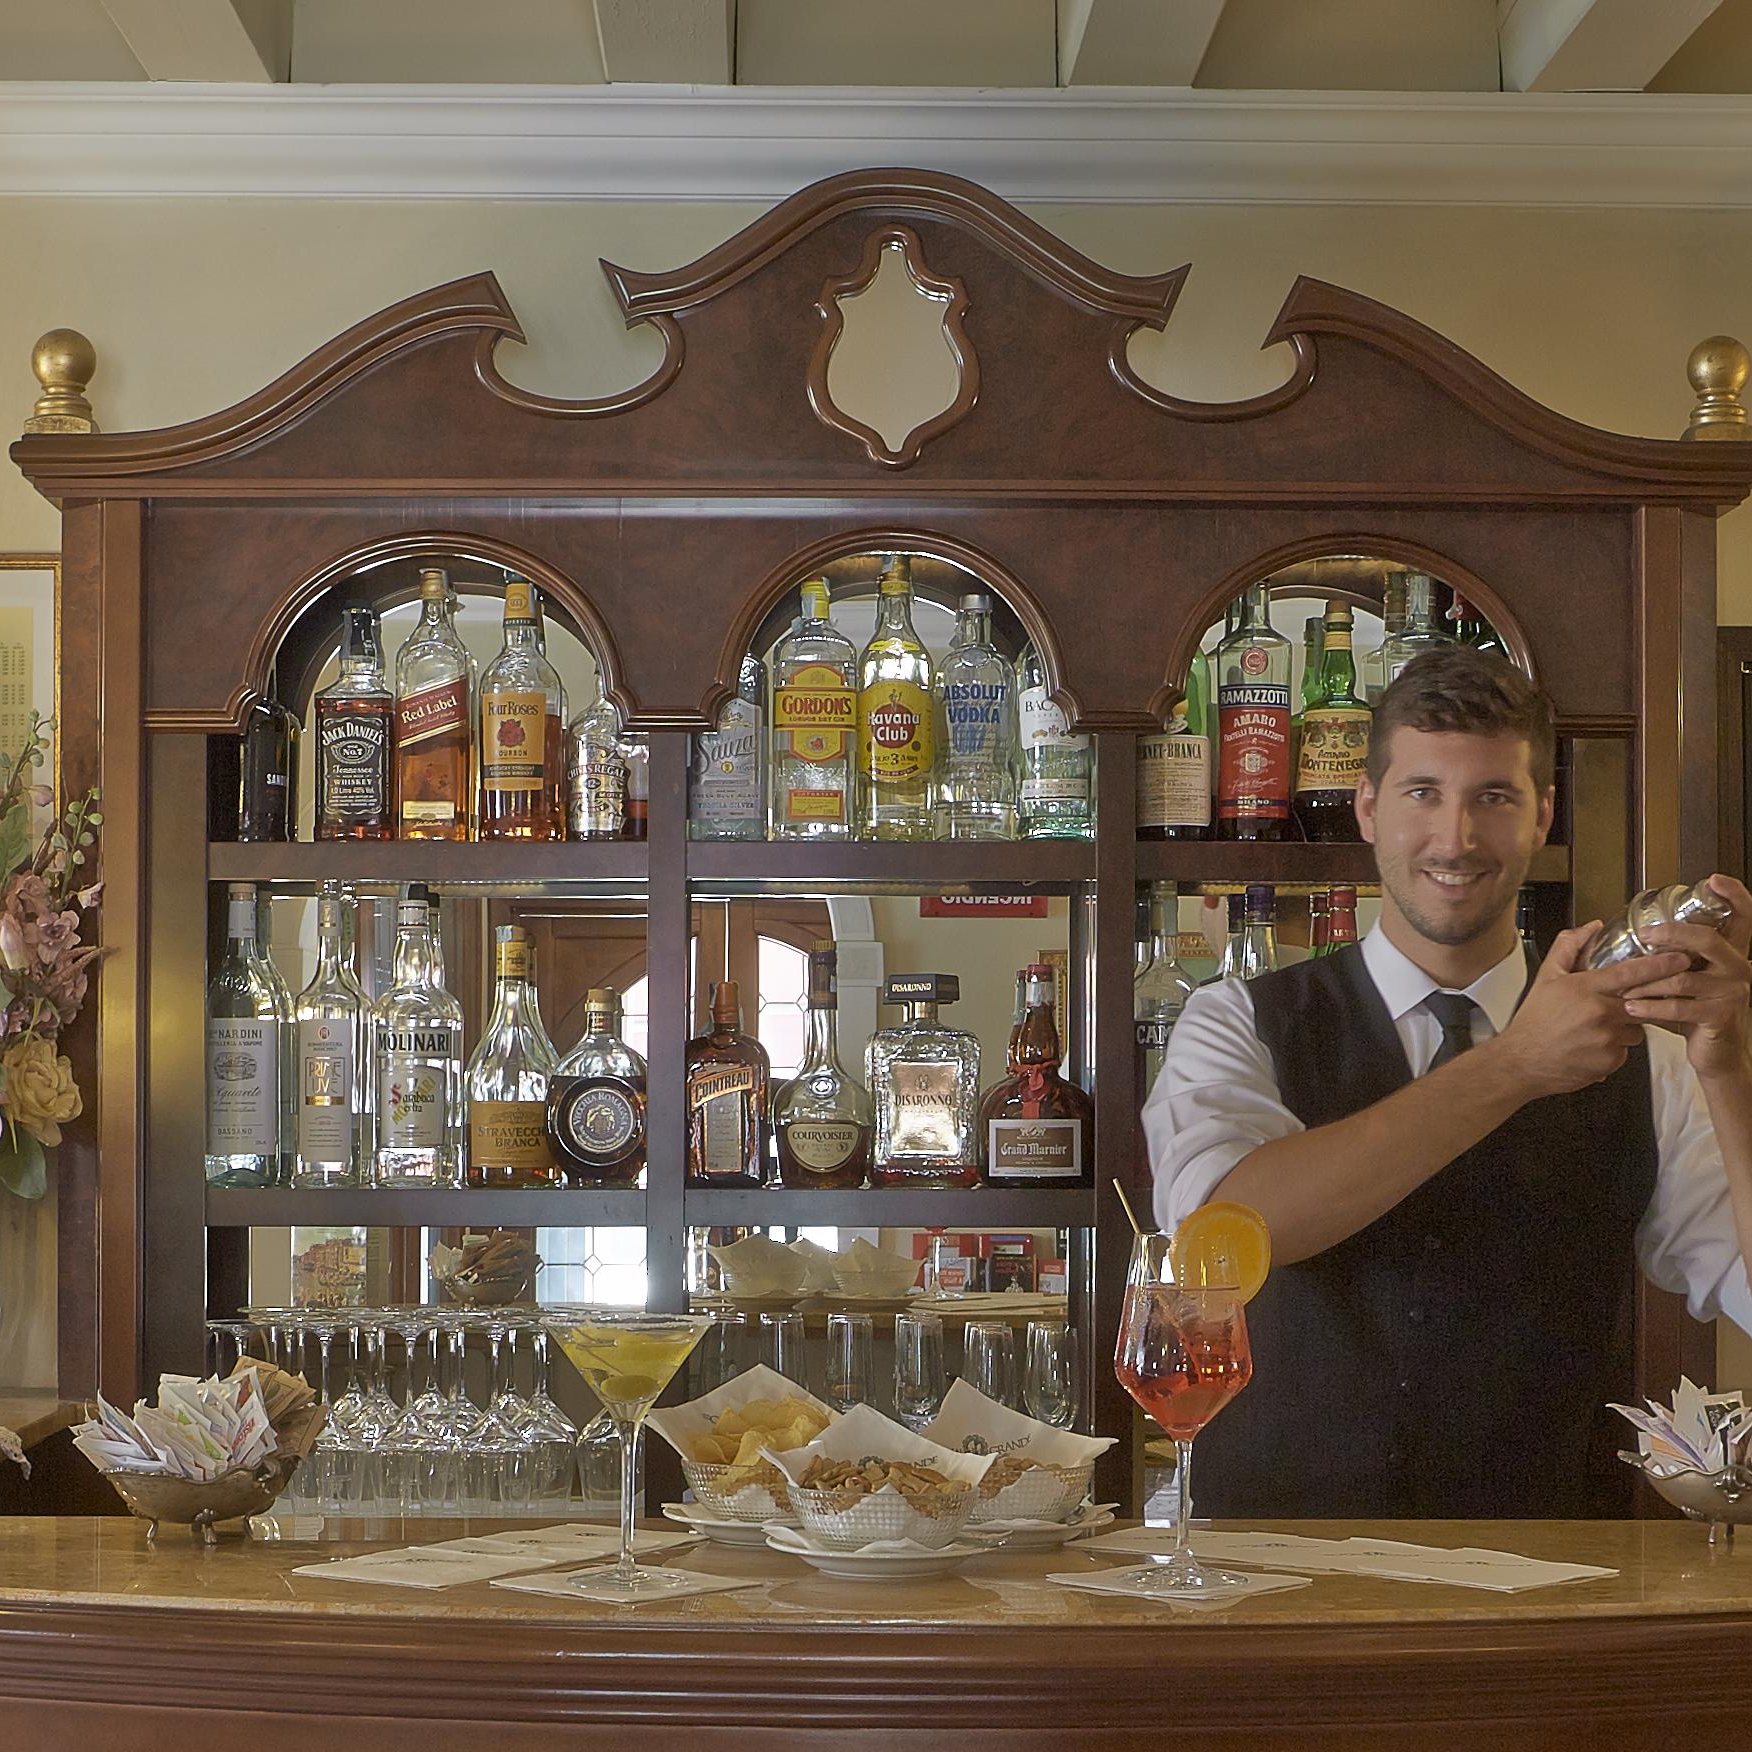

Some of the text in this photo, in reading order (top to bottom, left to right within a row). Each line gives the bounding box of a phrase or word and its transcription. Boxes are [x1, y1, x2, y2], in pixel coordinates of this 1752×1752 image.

[944, 684, 1007, 700] ABSOLUT
[1221, 689, 1288, 705] RAMAZZOTTI
[402, 695, 457, 723] Red Label
[488, 701, 538, 716] Four Roses
[782, 695, 852, 715] GORDON'S
[949, 705, 1000, 723] VODKA
[1234, 714, 1277, 728] AMARO
[867, 711, 921, 741] Havana Club
[322, 722, 384, 746] JACK DANIEL'S
[696, 736, 755, 775] Sauza
[890, 753, 899, 765] 3
[595, 764, 625, 778] REGAL
[218, 1029, 263, 1039] NARDINI
[378, 1033, 449, 1051] MOLINARI
[695, 1072, 750, 1100] COINTREAU
[895, 1094, 952, 1106] DISARONNO
[478, 1126, 545, 1137] STRAVECCH
[792, 1131, 853, 1142] COURVOISIER
[496, 1138, 540, 1147] BRANCA
[1000, 1142, 1067, 1156] Grand Marnier
